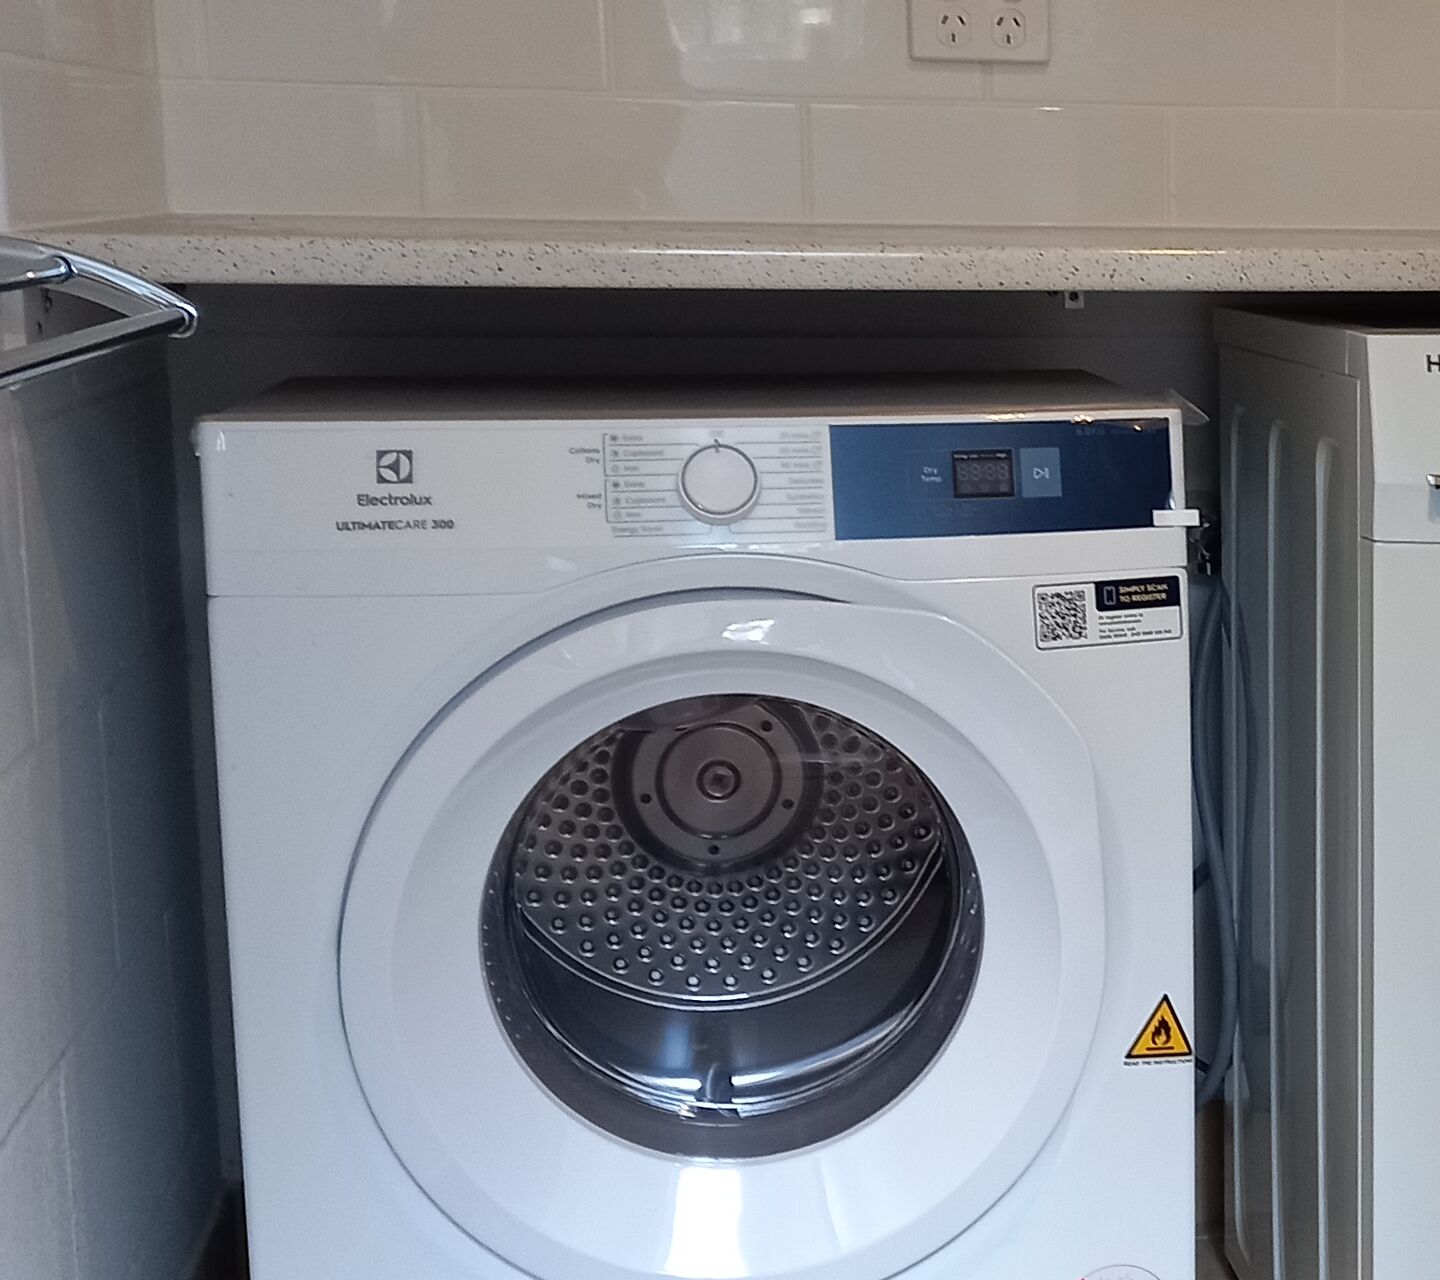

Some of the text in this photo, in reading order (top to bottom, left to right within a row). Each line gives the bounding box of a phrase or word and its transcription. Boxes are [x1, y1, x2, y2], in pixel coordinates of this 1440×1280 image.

[356, 492, 433, 507] Electrolux
[335, 519, 456, 532] ULTIMATECARE 300
[1118, 583, 1168, 594] SIMPLY SCAN
[1118, 592, 1167, 603] TO REGISTER
